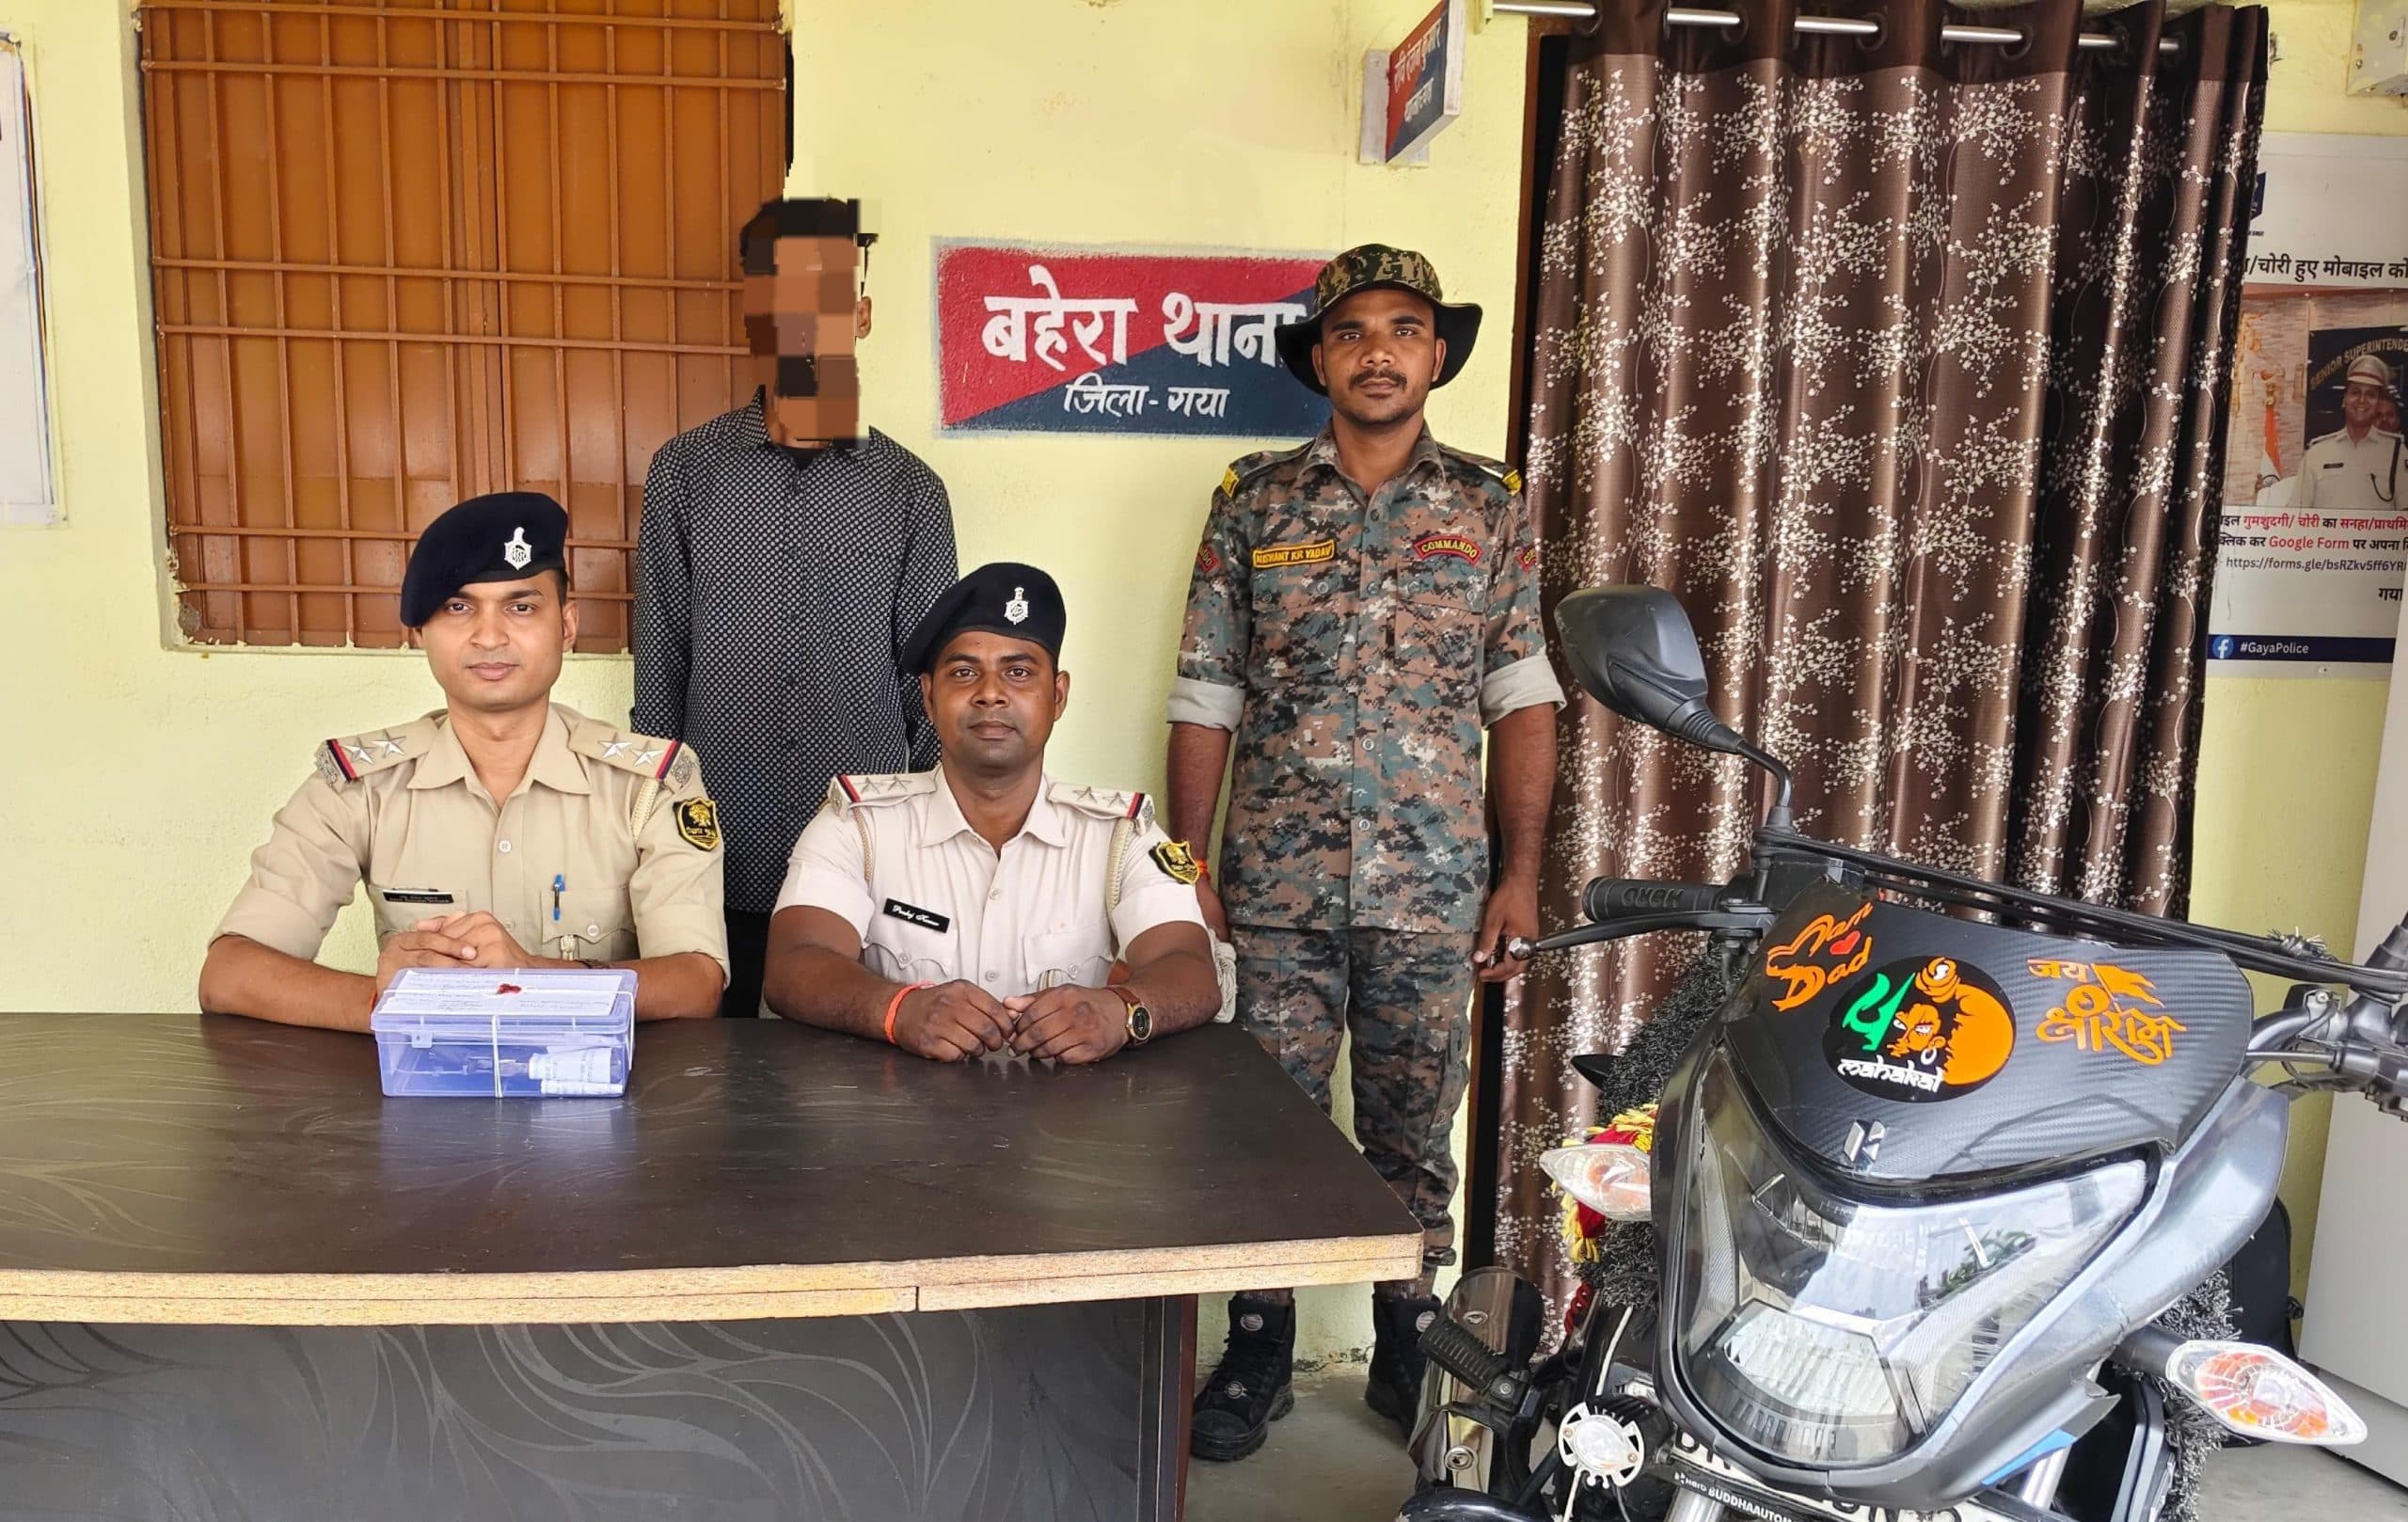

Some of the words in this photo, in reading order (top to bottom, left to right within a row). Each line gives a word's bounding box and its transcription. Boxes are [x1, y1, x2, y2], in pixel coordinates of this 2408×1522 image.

[2294, 260, 2320, 282] हुए
[2323, 255, 2385, 279] मोबाइल
[981, 264, 1138, 371] बहेरा
[1167, 387, 1230, 418] गया
[2298, 514, 2320, 528] चोरी
[2322, 518, 2337, 529] का
[1306, 545, 1333, 558] YADAV
[1421, 539, 1478, 558] COMMANDO
[2249, 536, 2267, 547] कर
[2269, 535, 2314, 551] Google
[2317, 537, 2350, 549] Form
[2353, 539, 2367, 549] पर
[2368, 540, 2400, 550] अपना
[2226, 556, 2407, 572] https://forms.gle/bsRZkv5ff6YR
[2240, 642, 2309, 657] #GayaPolice
[1766, 936, 1874, 1012] Dad
[2027, 959, 2089, 983] जय
